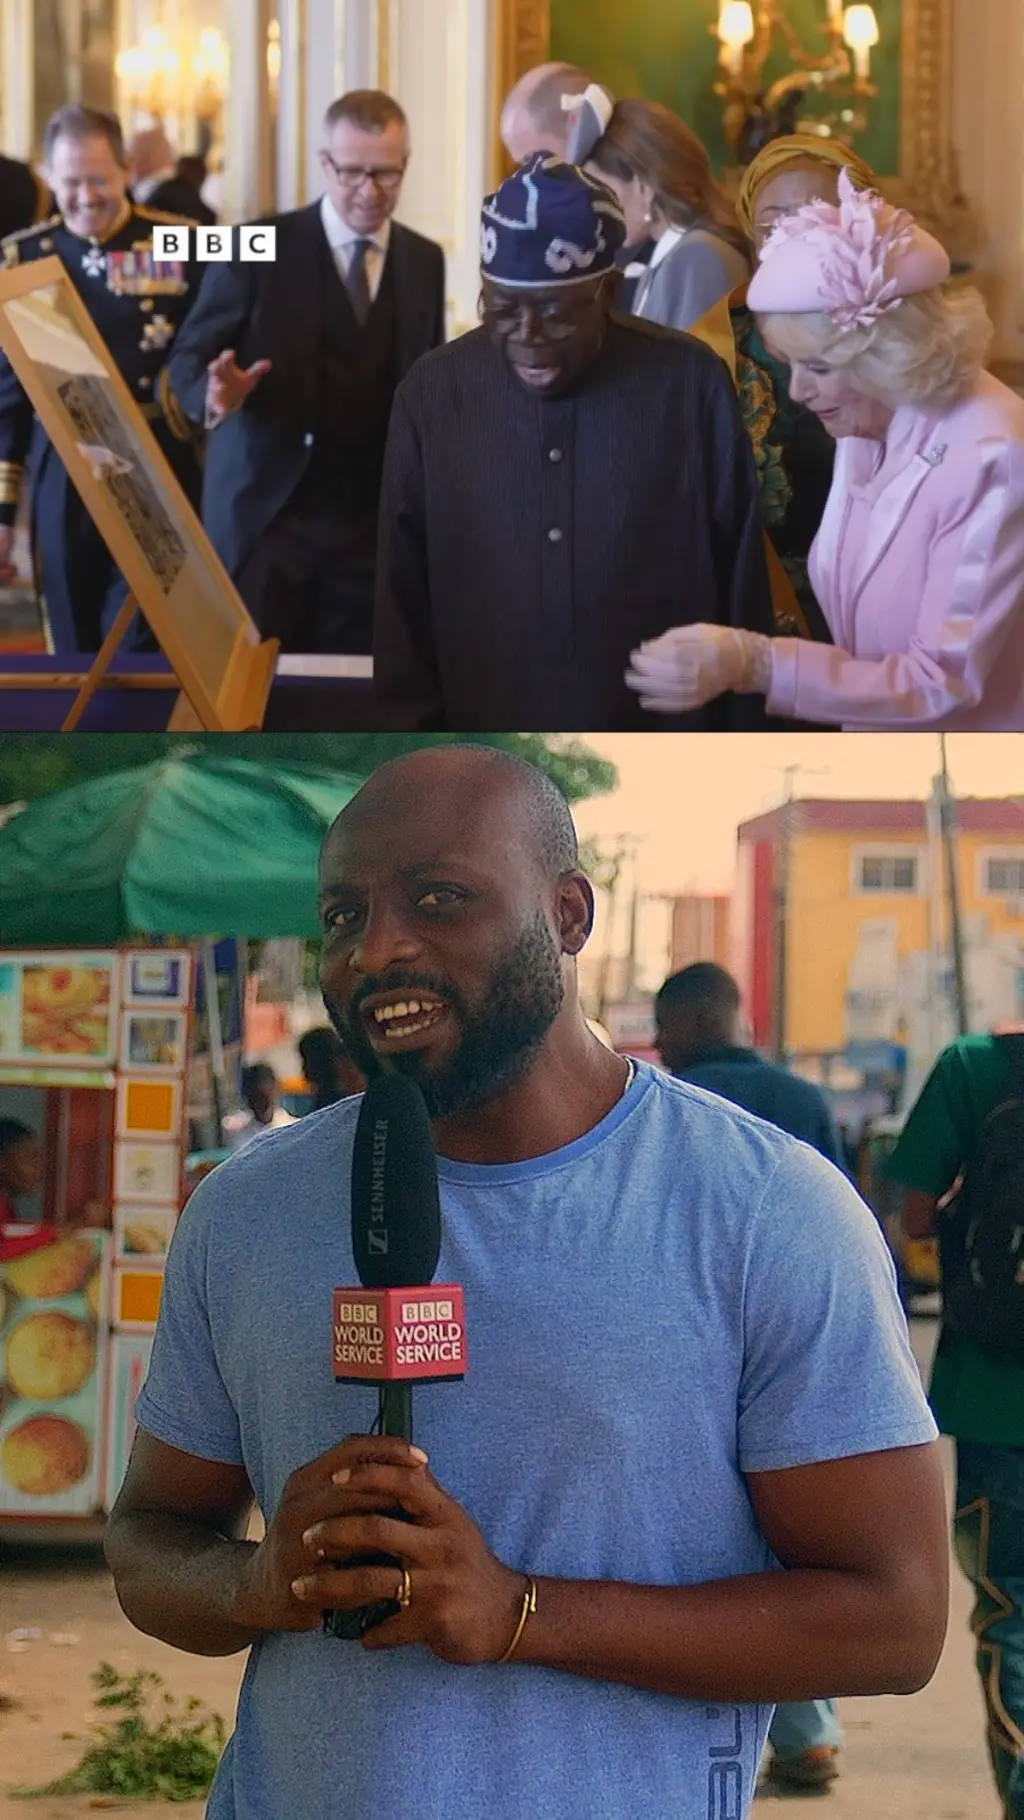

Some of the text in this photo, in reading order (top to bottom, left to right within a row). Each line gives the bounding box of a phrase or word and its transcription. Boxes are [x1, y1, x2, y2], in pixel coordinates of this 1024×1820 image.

[371, 1118, 389, 1223] SENNHEISER
[342, 1305, 376, 1321] BBC
[404, 1303, 451, 1321] BBC
[335, 1325, 384, 1344] WORLD
[395, 1323, 462, 1344] WORLD
[335, 1345, 383, 1364] SERVICE
[396, 1342, 462, 1364] SERVICE
